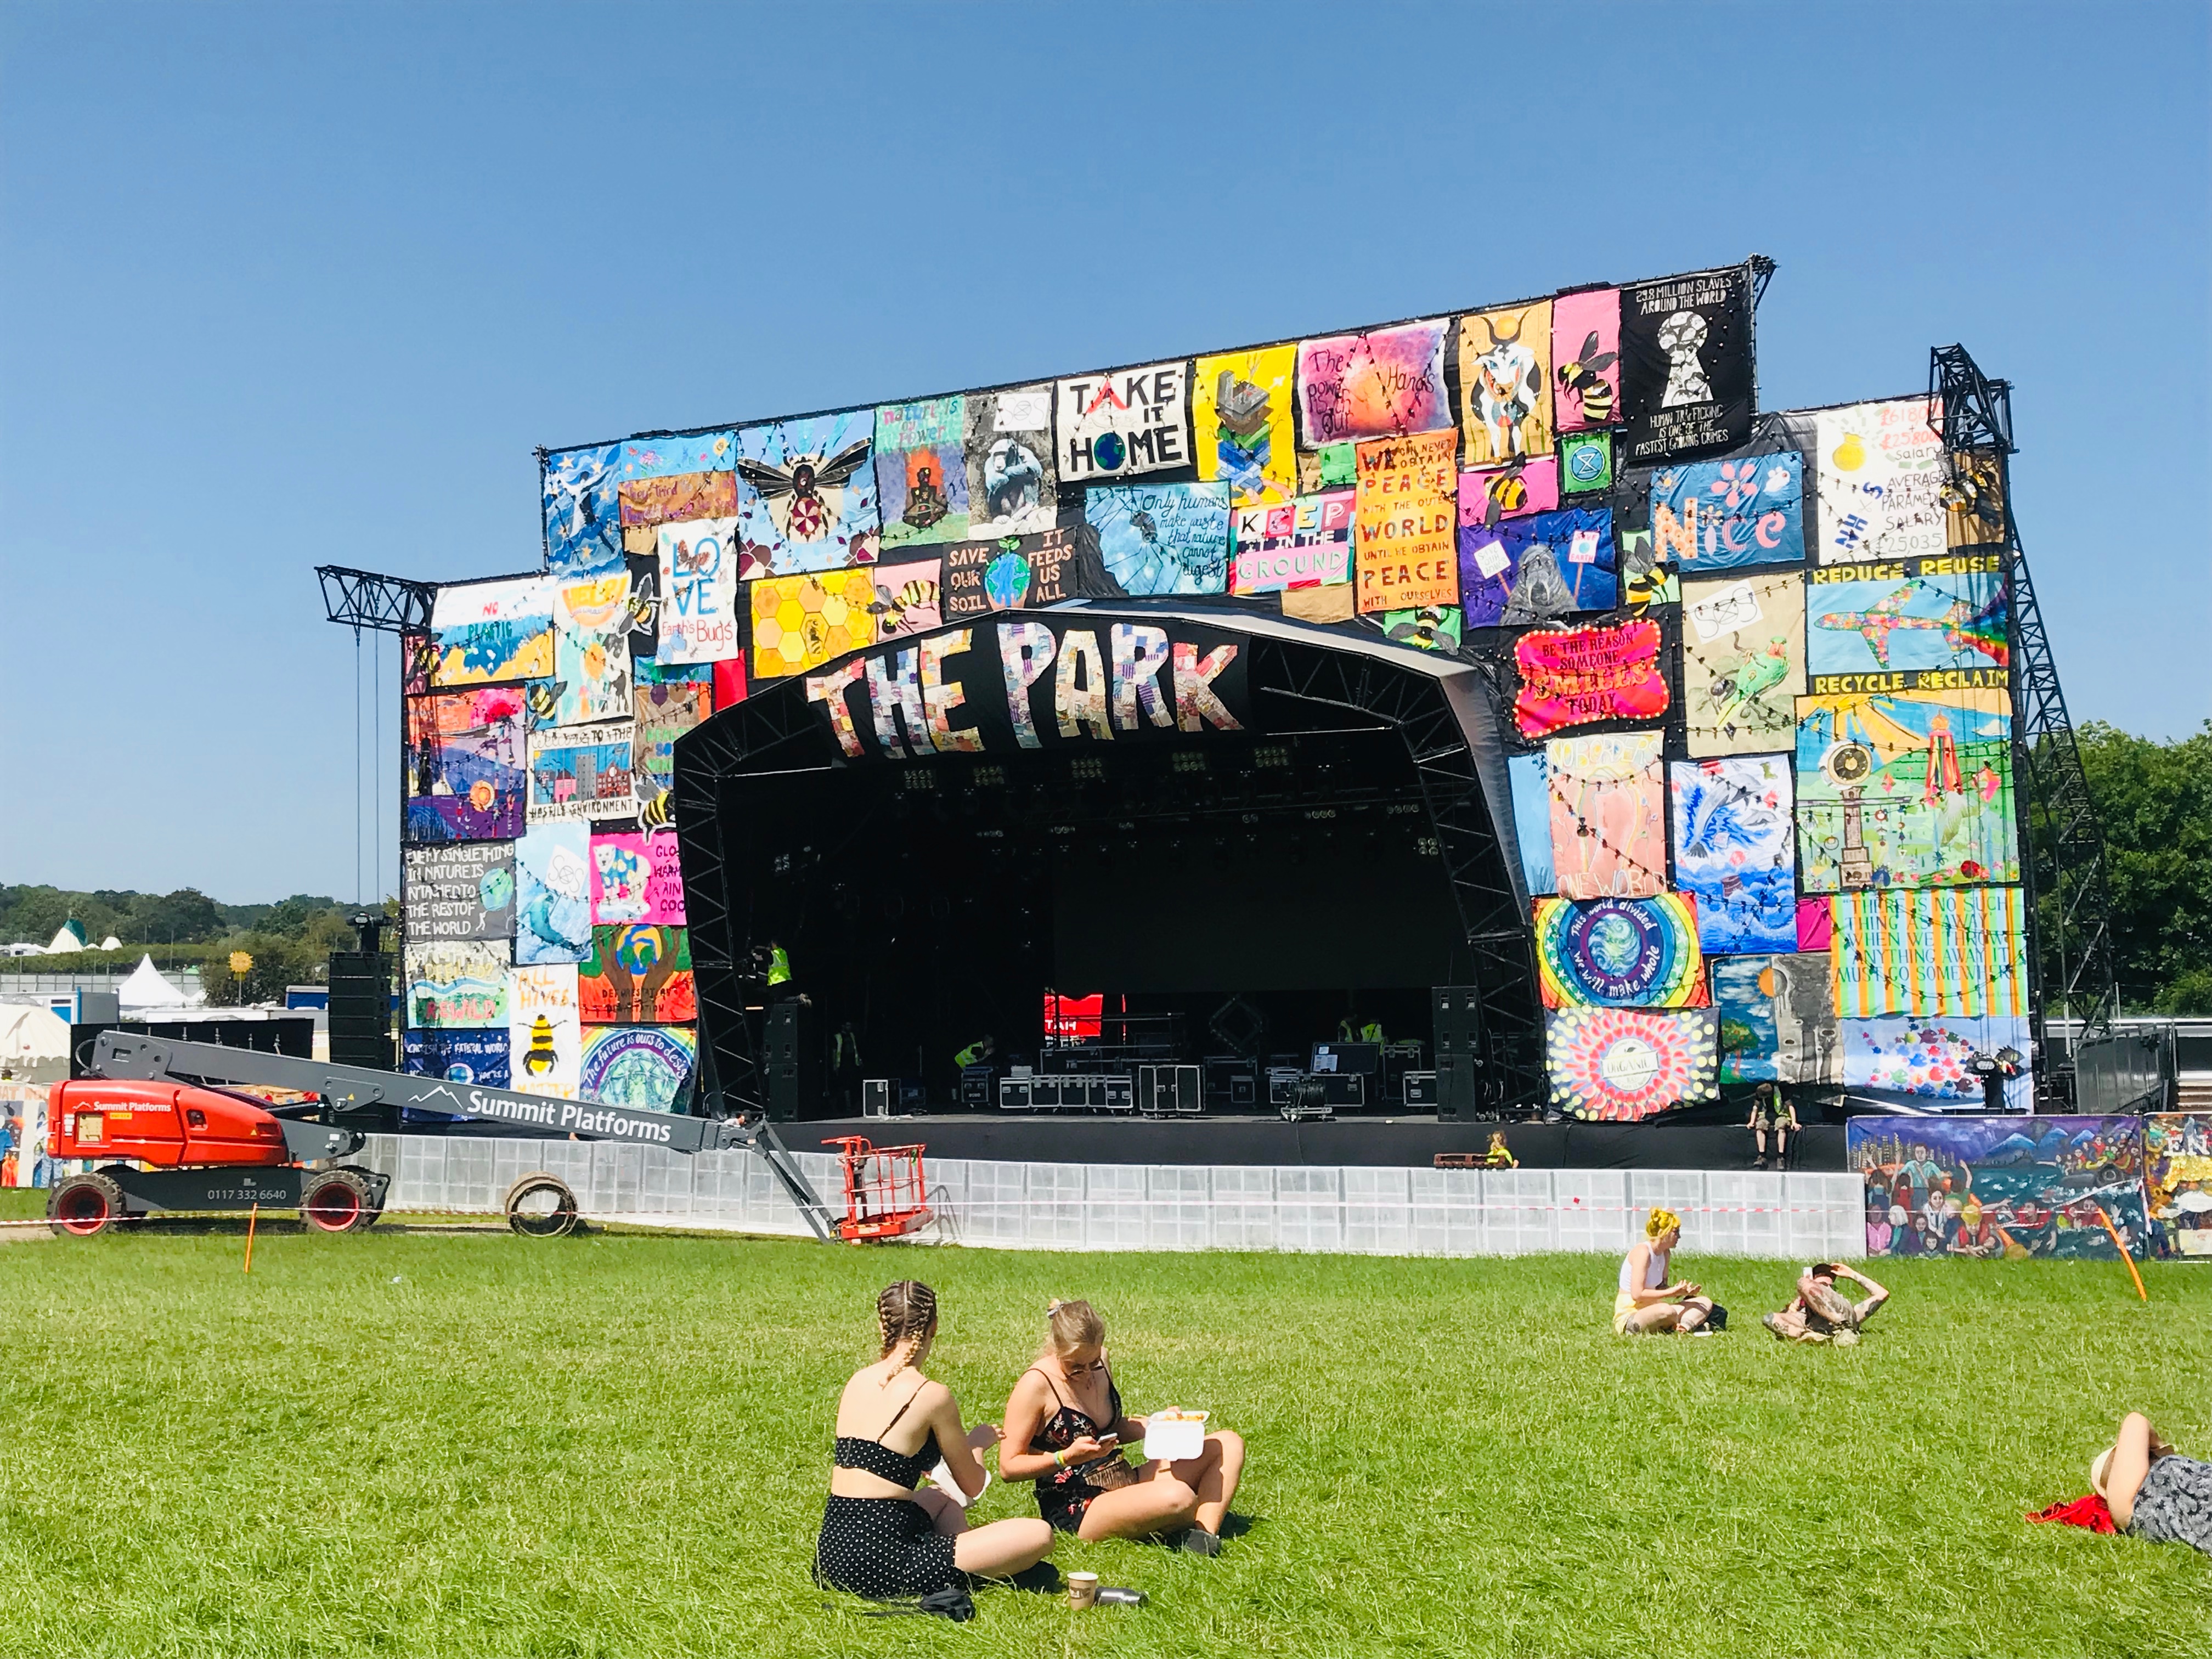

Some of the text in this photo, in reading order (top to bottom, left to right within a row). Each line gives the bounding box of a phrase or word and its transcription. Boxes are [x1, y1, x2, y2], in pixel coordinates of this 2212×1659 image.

[1656, 276, 1733, 299] MILLION SLAVES
[1640, 289, 1726, 316] AROUND THE WORLD
[1309, 349, 1344, 374] The
[1387, 364, 1435, 394] Hands
[1070, 370, 1177, 415] TAKE
[1144, 406, 1164, 423] IT
[1650, 413, 1673, 429] HUMAN
[1659, 419, 1714, 438] IS ONE OF THE
[1070, 424, 1182, 472] HOME
[1635, 438, 1667, 456] FASTEST
[1701, 429, 1729, 444] CRIMES
[1362, 447, 1397, 471] WE
[1422, 439, 1451, 453] NEVER
[1401, 452, 1451, 469] OBTAIN
[1364, 467, 1450, 496] PEACE
[1142, 490, 1229, 518] Only humans
[1363, 501, 1411, 514] WITH THE
[1159, 511, 1224, 531] make waste
[1241, 502, 1345, 535] KEEP
[1361, 515, 1448, 543] WORLD
[1885, 511, 1945, 531] SALARY
[1043, 528, 1065, 548] IT
[1168, 528, 1226, 546] that nature
[1246, 531, 1335, 554] IT IN THE
[949, 547, 989, 567] SAVE
[1028, 544, 1073, 568] FEEDS
[1364, 549, 1392, 561] UNTIL
[1412, 540, 1449, 554] OBTAIN
[1040, 564, 1061, 584] US
[1181, 558, 1224, 585] digest
[1238, 551, 1342, 580] GROUND
[1364, 560, 1449, 589] PEACE
[1813, 555, 2000, 585] REDUCE REUSE
[950, 569, 981, 589] OUR
[950, 594, 986, 612] SOIL
[1036, 583, 1067, 602] ALL
[1364, 588, 1452, 608] WITH OURSELVES
[482, 601, 499, 617] NO
[468, 621, 512, 642] PLASTIC
[662, 619, 733, 652] Earth's Bugs
[1542, 631, 1633, 657] BE THE REASON
[1560, 649, 1619, 672] SOMEONE
[806, 622, 1246, 759] THE PARK
[1534, 662, 1649, 700] SMILES
[1815, 669, 2010, 694] RECYCLE RECLAIM
[1570, 693, 1617, 715] TODAY
[1548, 736, 1660, 769] NO BORDERS
[480, 843, 515, 862] THING
[424, 864, 472, 881] NATURE
[471, 863, 485, 879] IS
[407, 883, 477, 901] ATTACHED TO
[1557, 869, 1667, 900] ONE WORLD
[405, 900, 477, 919] THE REST OF
[1912, 895, 2008, 912] IS NO SUCH
[407, 920, 472, 936] THE WORLD
[1571, 898, 1658, 937] This world divided
[1845, 915, 1932, 930] THING AS
[1848, 929, 2004, 947] WHEN WE THROW
[1852, 947, 2010, 964] ANYTHING AWAY IT
[518, 967, 555, 990] ALL
[1582, 969, 1605, 993] will
[1609, 979, 1641, 997] make
[1640, 944, 1660, 982] whole
[1835, 967, 1884, 983] MUST
[1888, 966, 1909, 981] GO
[426, 998, 496, 1020] REWILD
[520, 989, 569, 1010] HIVES
[582, 1062, 601, 1087] The
[597, 1037, 627, 1068] future
[626, 1032, 635, 1046] is
[635, 1033, 654, 1046] ours
[654, 1037, 665, 1049] to
[93, 1101, 171, 1112] Summit Platforms
[466, 1090, 672, 1142] Summit Platforms
[207, 1189, 286, 1200] 0117 332 6640
